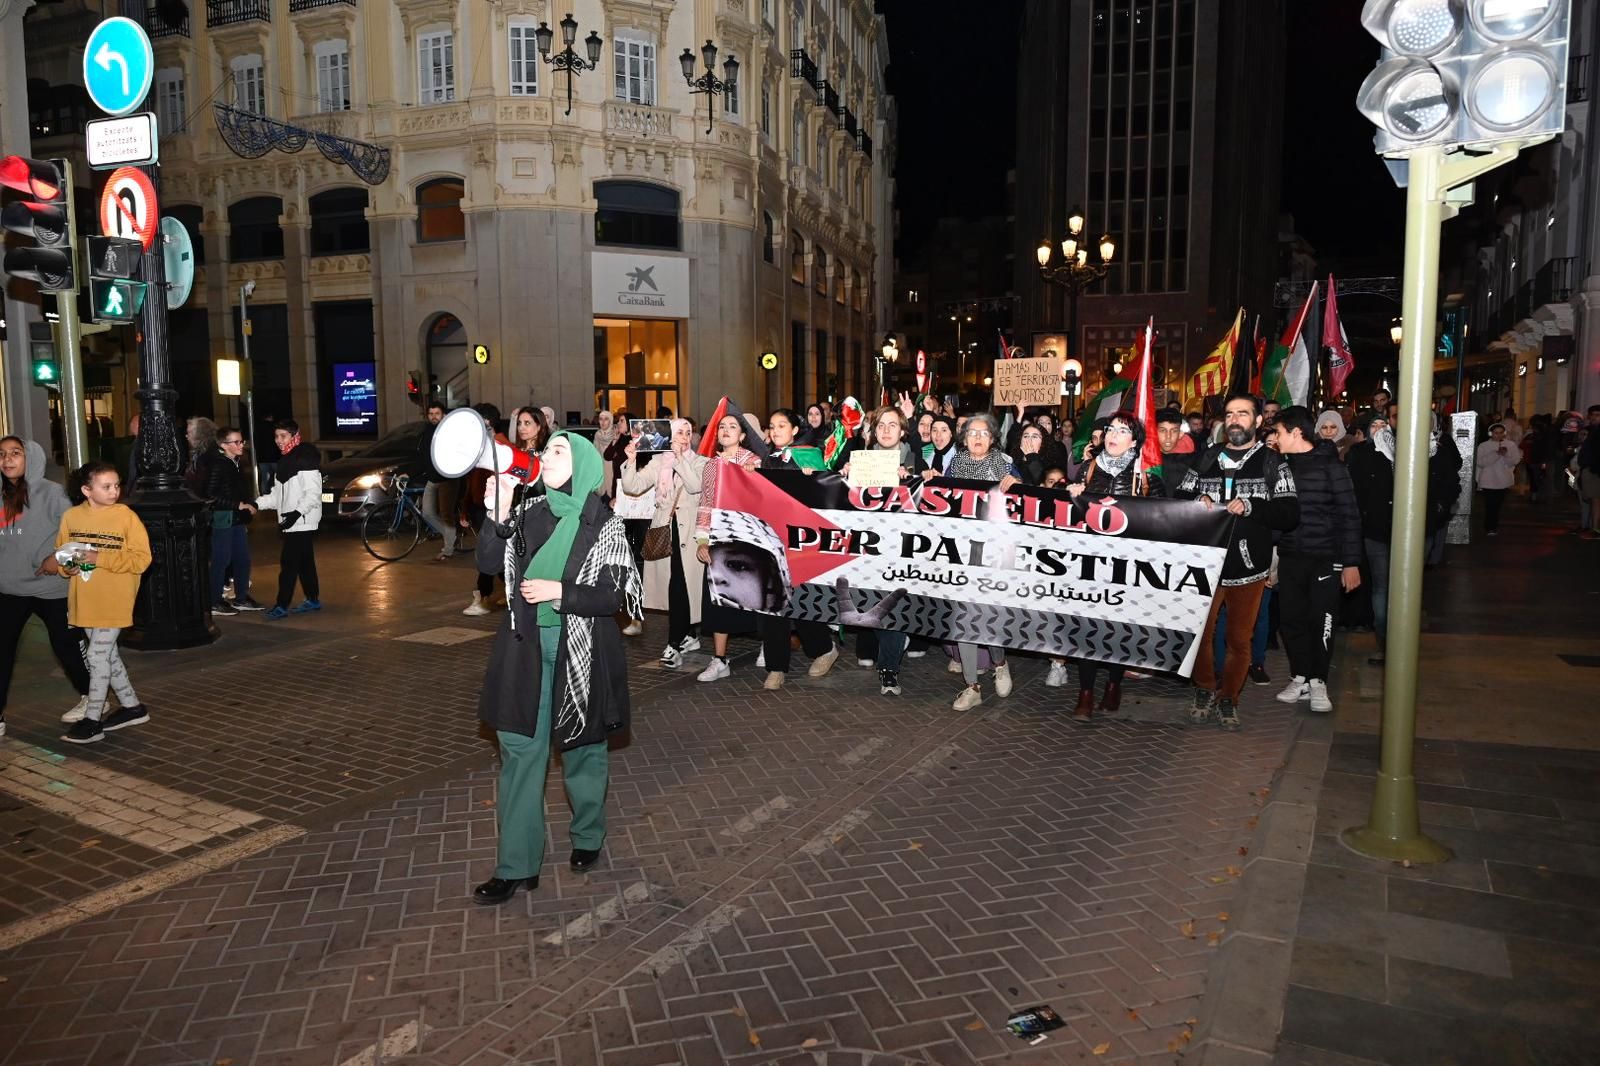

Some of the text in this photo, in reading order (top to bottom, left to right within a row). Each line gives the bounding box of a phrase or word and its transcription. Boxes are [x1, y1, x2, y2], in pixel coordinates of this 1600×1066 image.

[617, 294, 666, 307] CaixaBank
[1035, 361, 1049, 374] NO
[999, 376, 1012, 387] ES
[848, 486, 1129, 536] CASTELLÓ
[786, 524, 1213, 598] PER PALESTINA
[881, 564, 1126, 606] كاستيلون مع فلسطين
